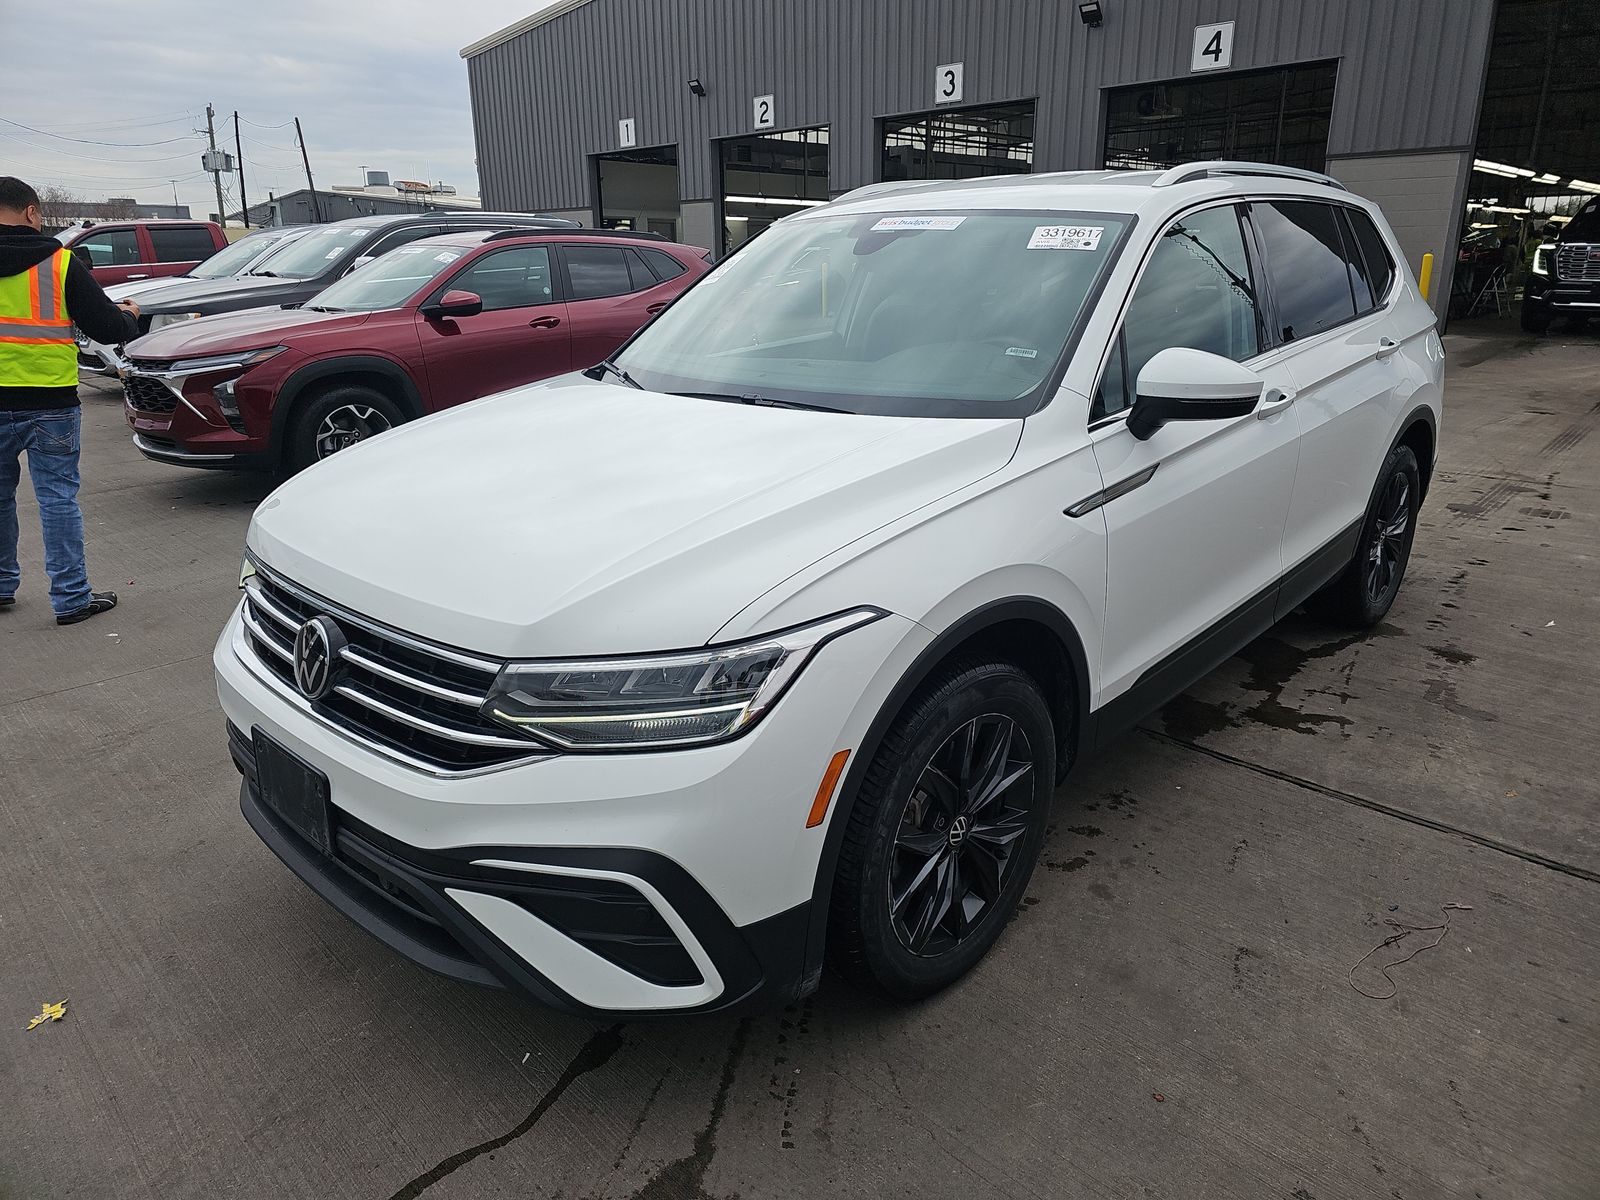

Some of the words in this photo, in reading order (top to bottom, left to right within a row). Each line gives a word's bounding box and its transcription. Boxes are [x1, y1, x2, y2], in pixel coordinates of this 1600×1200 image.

[1202, 30, 1222, 62] 4
[942, 69, 956, 97] 3
[759, 100, 770, 124] 2
[623, 123, 630, 143] 1
[898, 218, 933, 227] budget
[1040, 228, 1103, 238] 3319617
